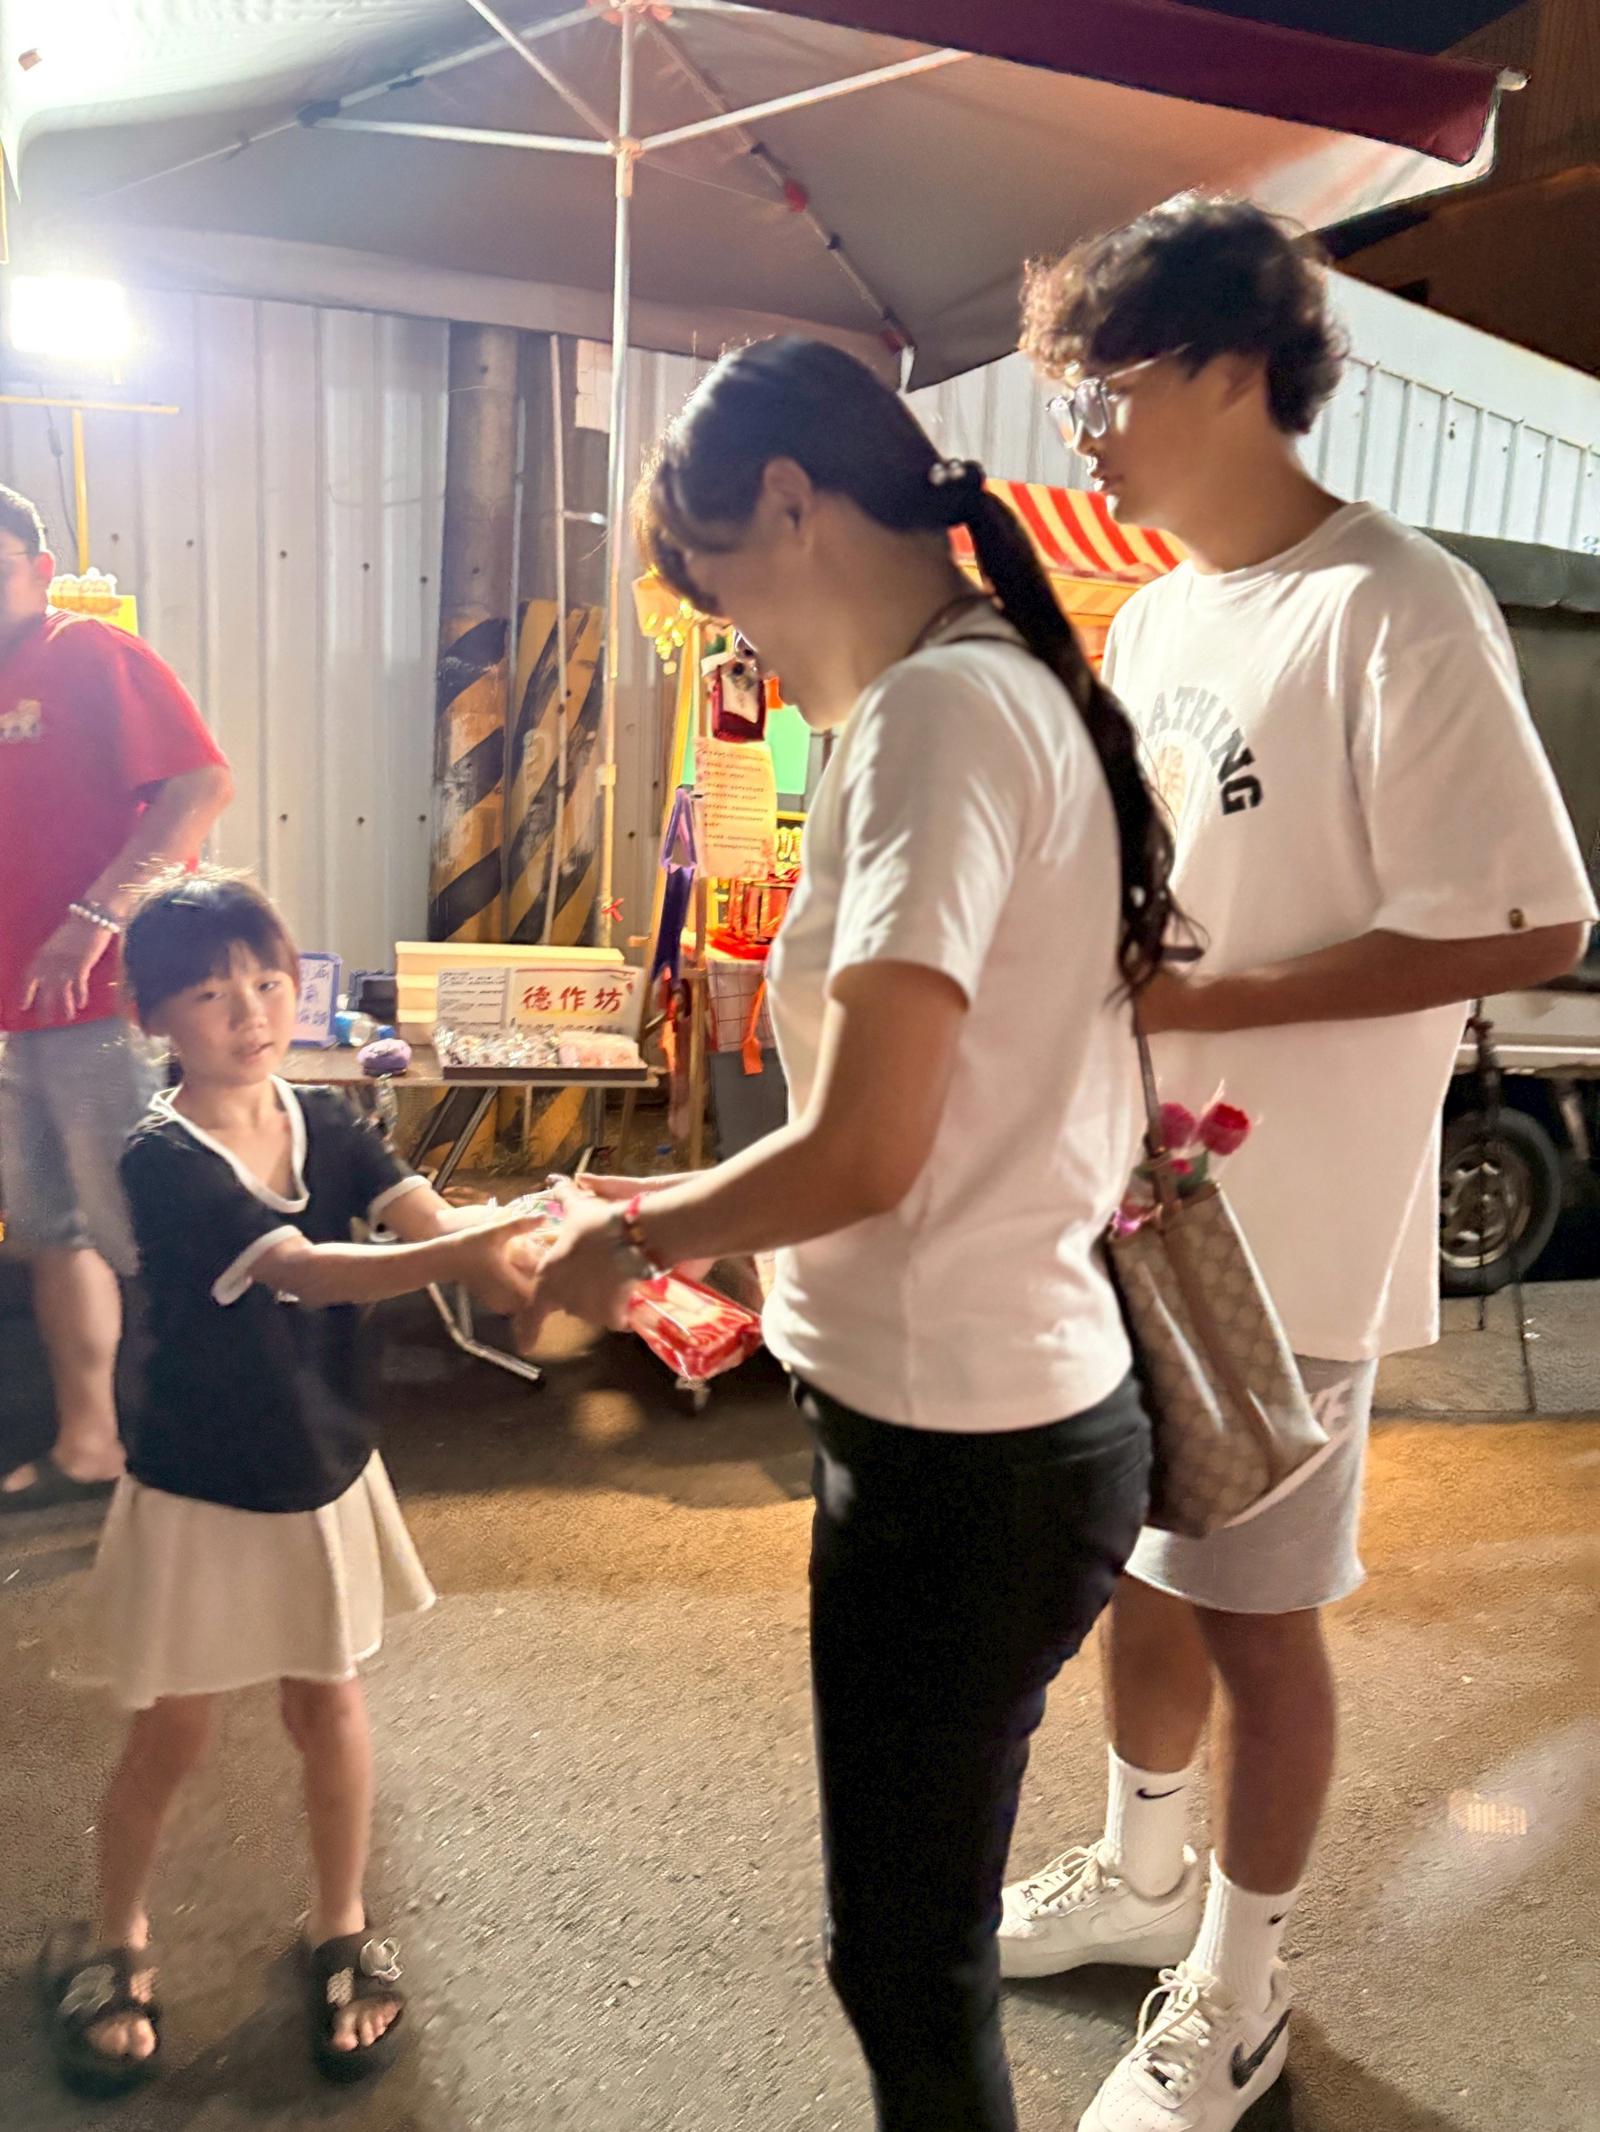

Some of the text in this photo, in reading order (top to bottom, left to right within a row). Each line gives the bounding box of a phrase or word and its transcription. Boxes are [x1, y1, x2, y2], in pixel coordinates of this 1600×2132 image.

[1138, 686, 1262, 816] ATHING
[523, 985, 623, 1014] 德作坊
